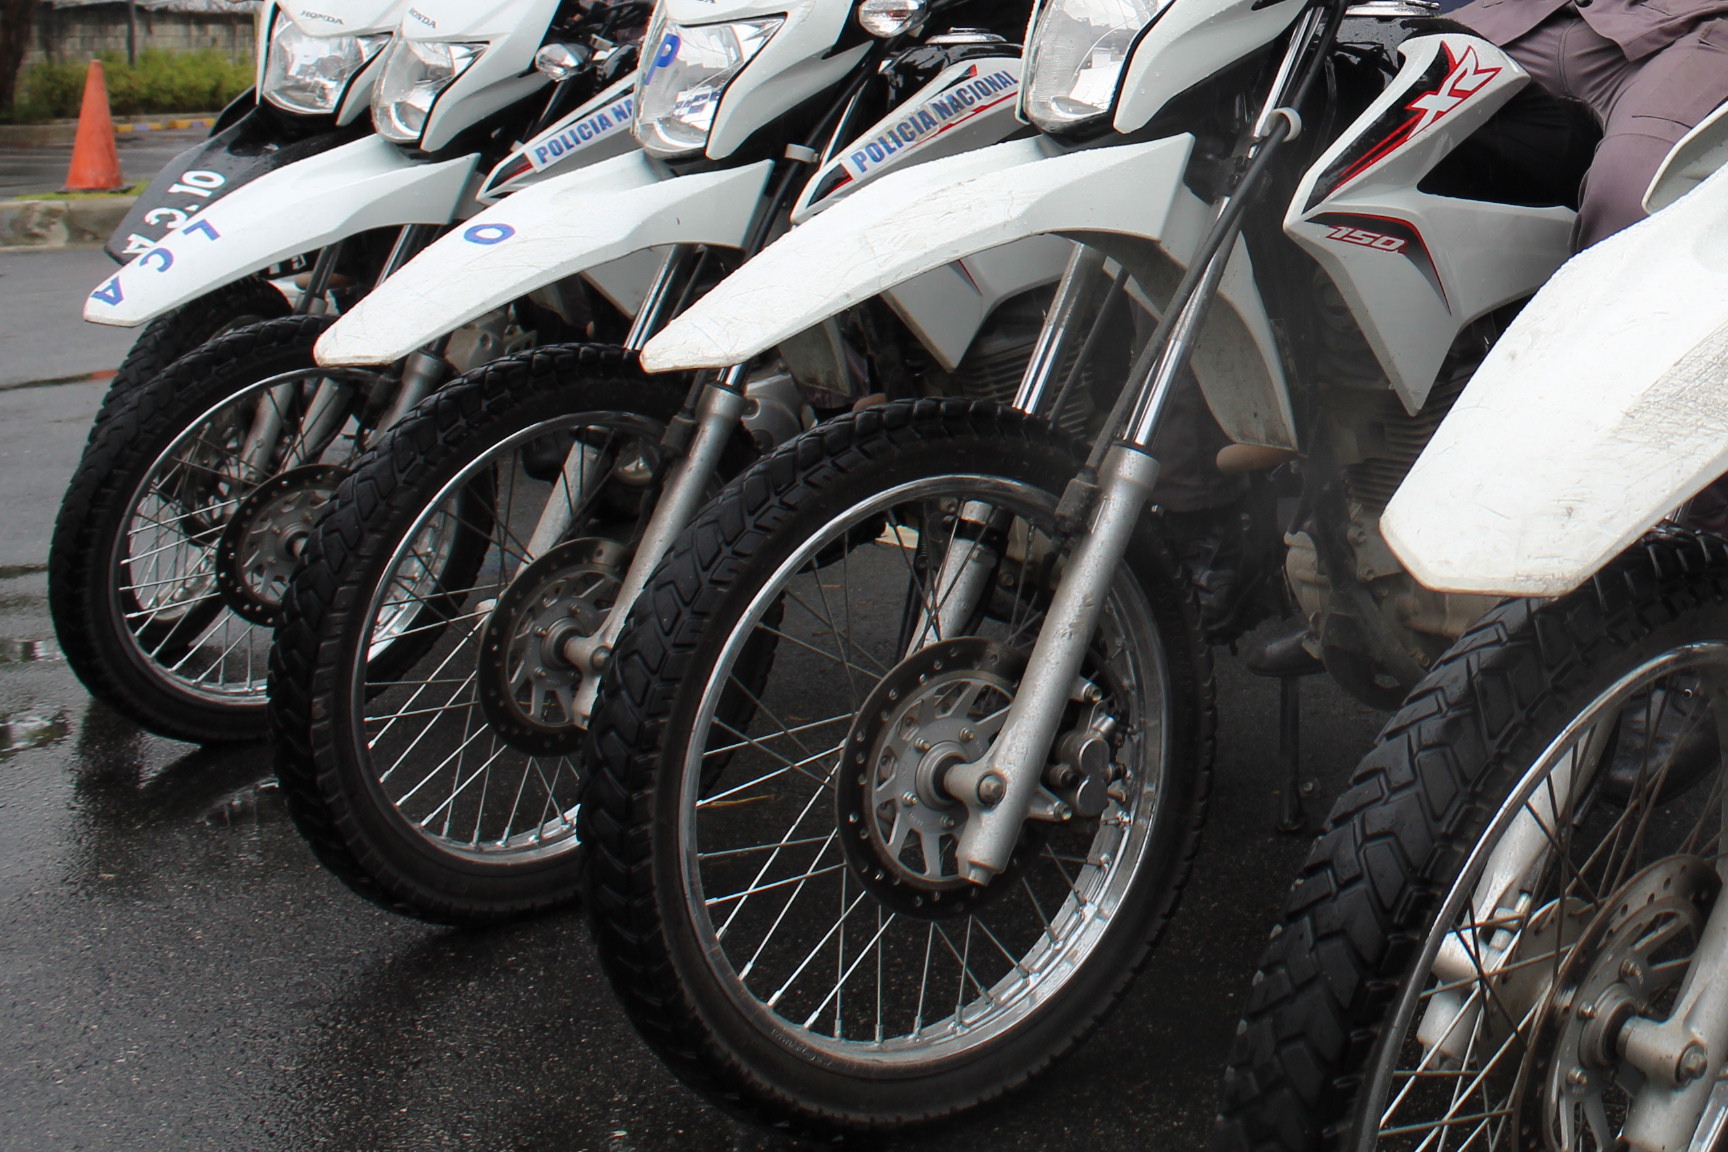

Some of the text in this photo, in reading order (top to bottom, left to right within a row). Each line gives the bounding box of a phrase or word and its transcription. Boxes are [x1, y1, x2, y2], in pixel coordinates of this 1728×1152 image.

[300, 10, 345, 25] HONDA
[408, 7, 438, 29] HONDA
[1404, 45, 1503, 141] XR
[534, 114, 614, 165] POLICIA
[850, 70, 1019, 174] POLICIA NACIONAL
[1326, 225, 1408, 252] 150
